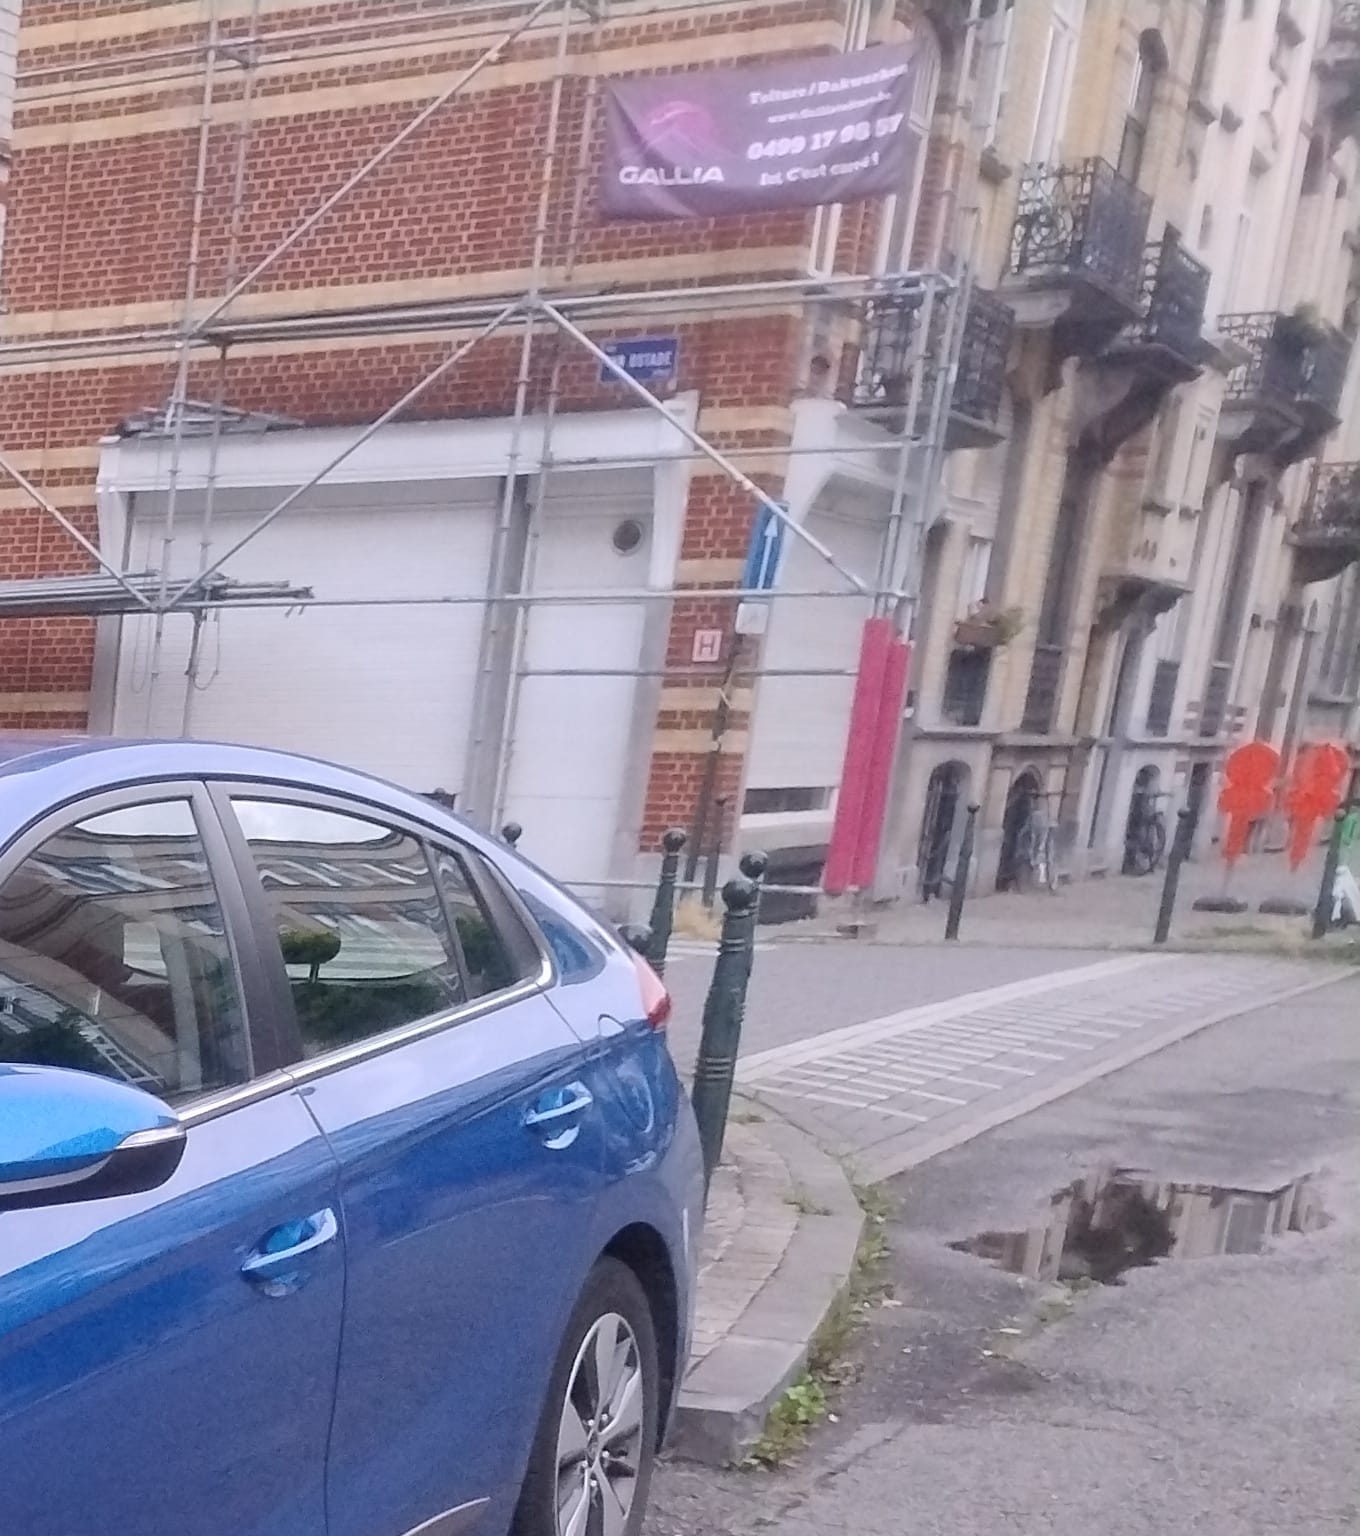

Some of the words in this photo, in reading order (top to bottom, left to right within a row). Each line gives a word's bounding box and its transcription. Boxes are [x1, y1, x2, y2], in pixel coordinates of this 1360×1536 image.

[810, 130, 837, 150] 17
[619, 166, 725, 185] GALLIA
[700, 632, 716, 656] H
